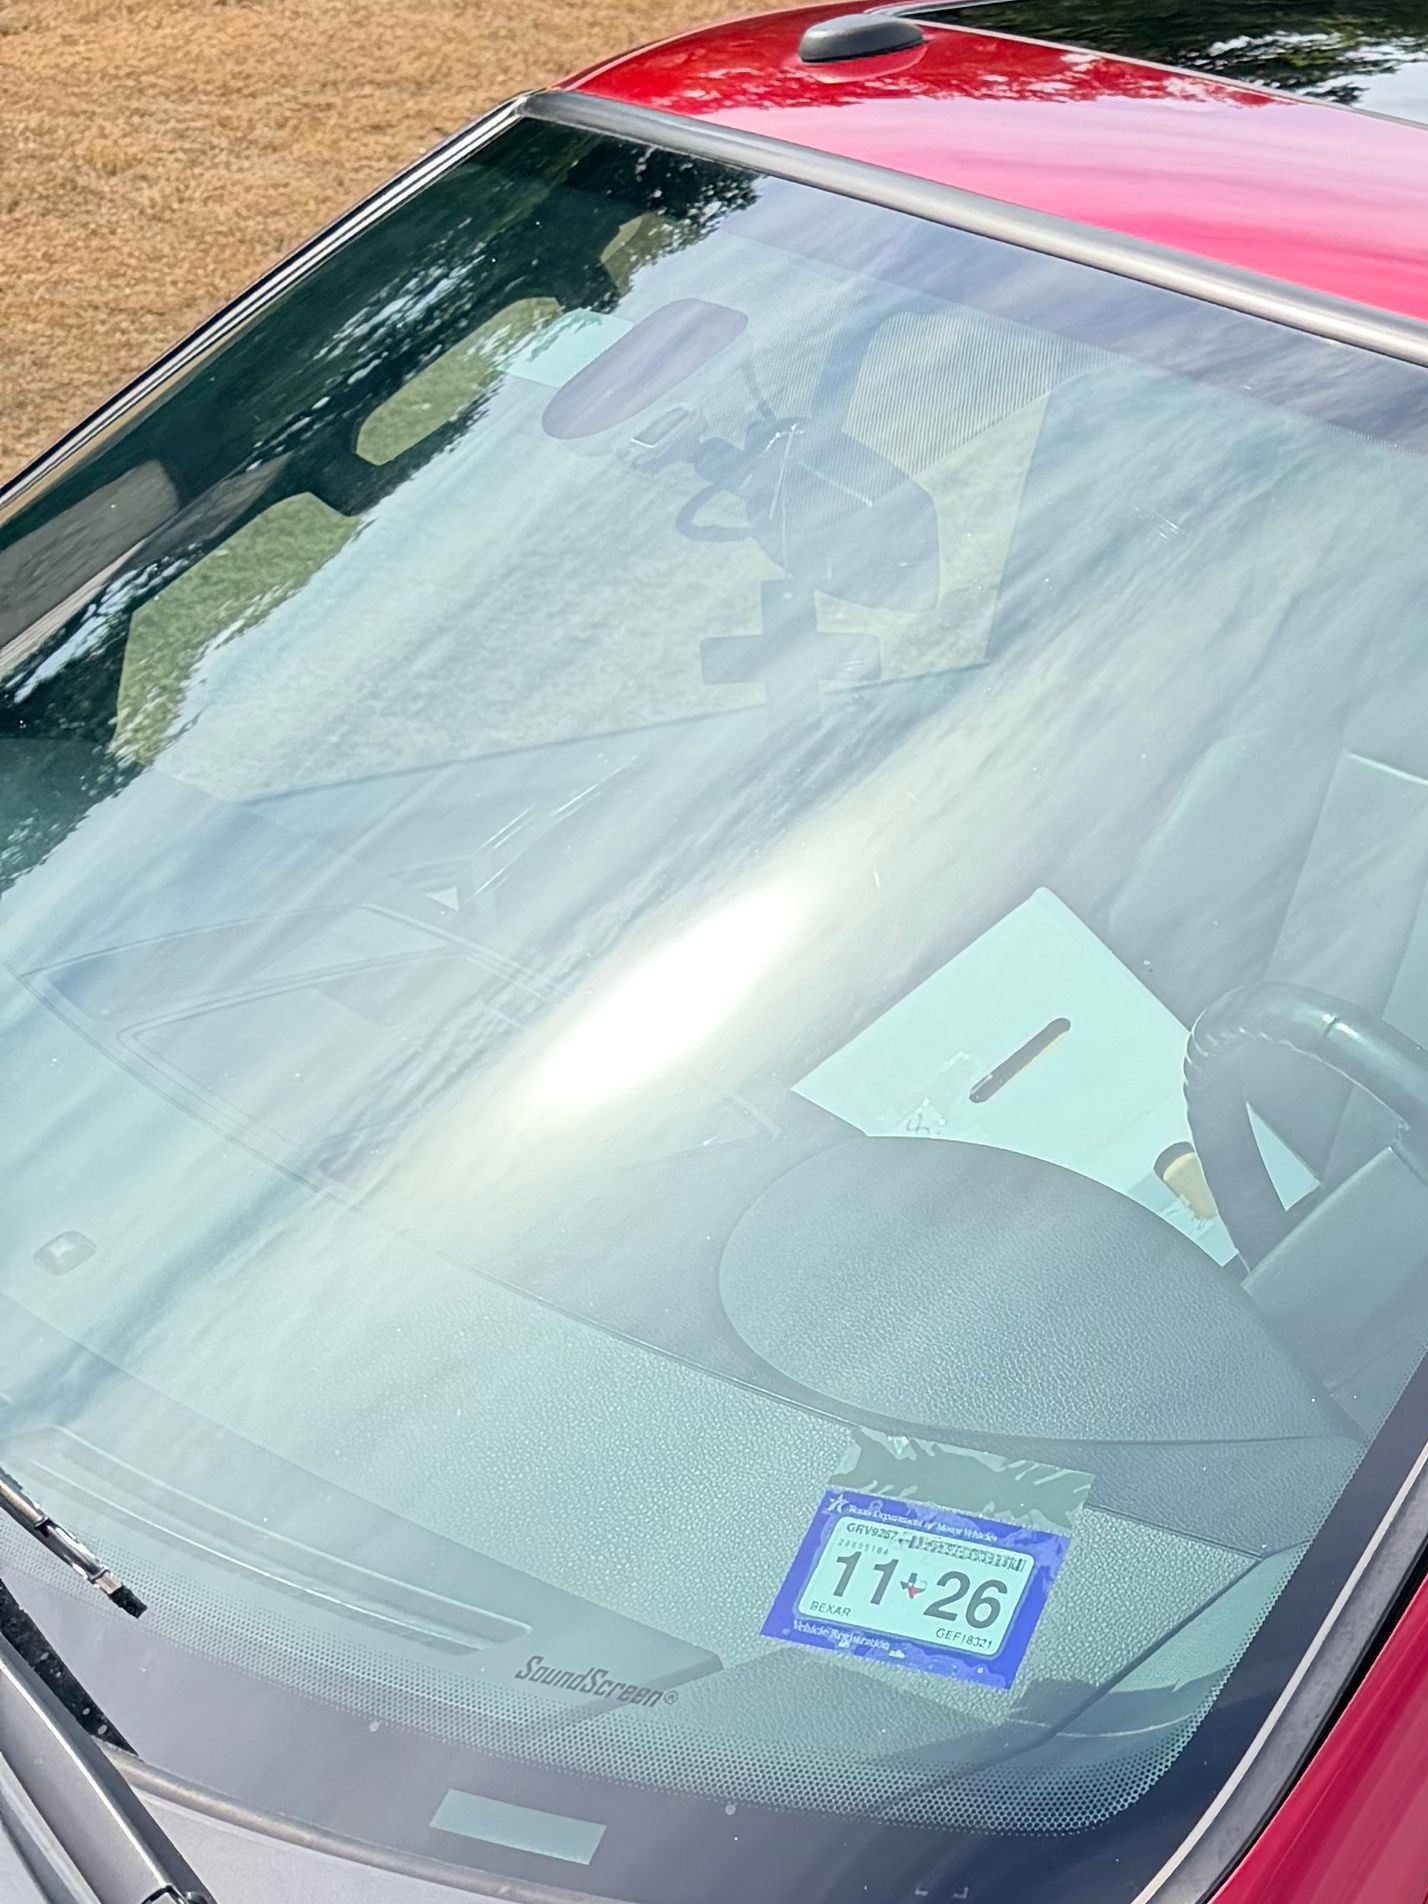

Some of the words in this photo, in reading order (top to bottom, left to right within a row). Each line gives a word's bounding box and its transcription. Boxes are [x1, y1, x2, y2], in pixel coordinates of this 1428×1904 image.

[847, 1504, 873, 1517] Texas
[873, 1510, 923, 1528] Department
[962, 1526, 998, 1542] Vehicles
[833, 1551, 899, 1606] 11
[923, 1570, 1009, 1630] 26
[810, 1600, 851, 1618] BEXAR
[793, 1620, 829, 1639] Vehicle
[829, 1628, 890, 1650] Registration
